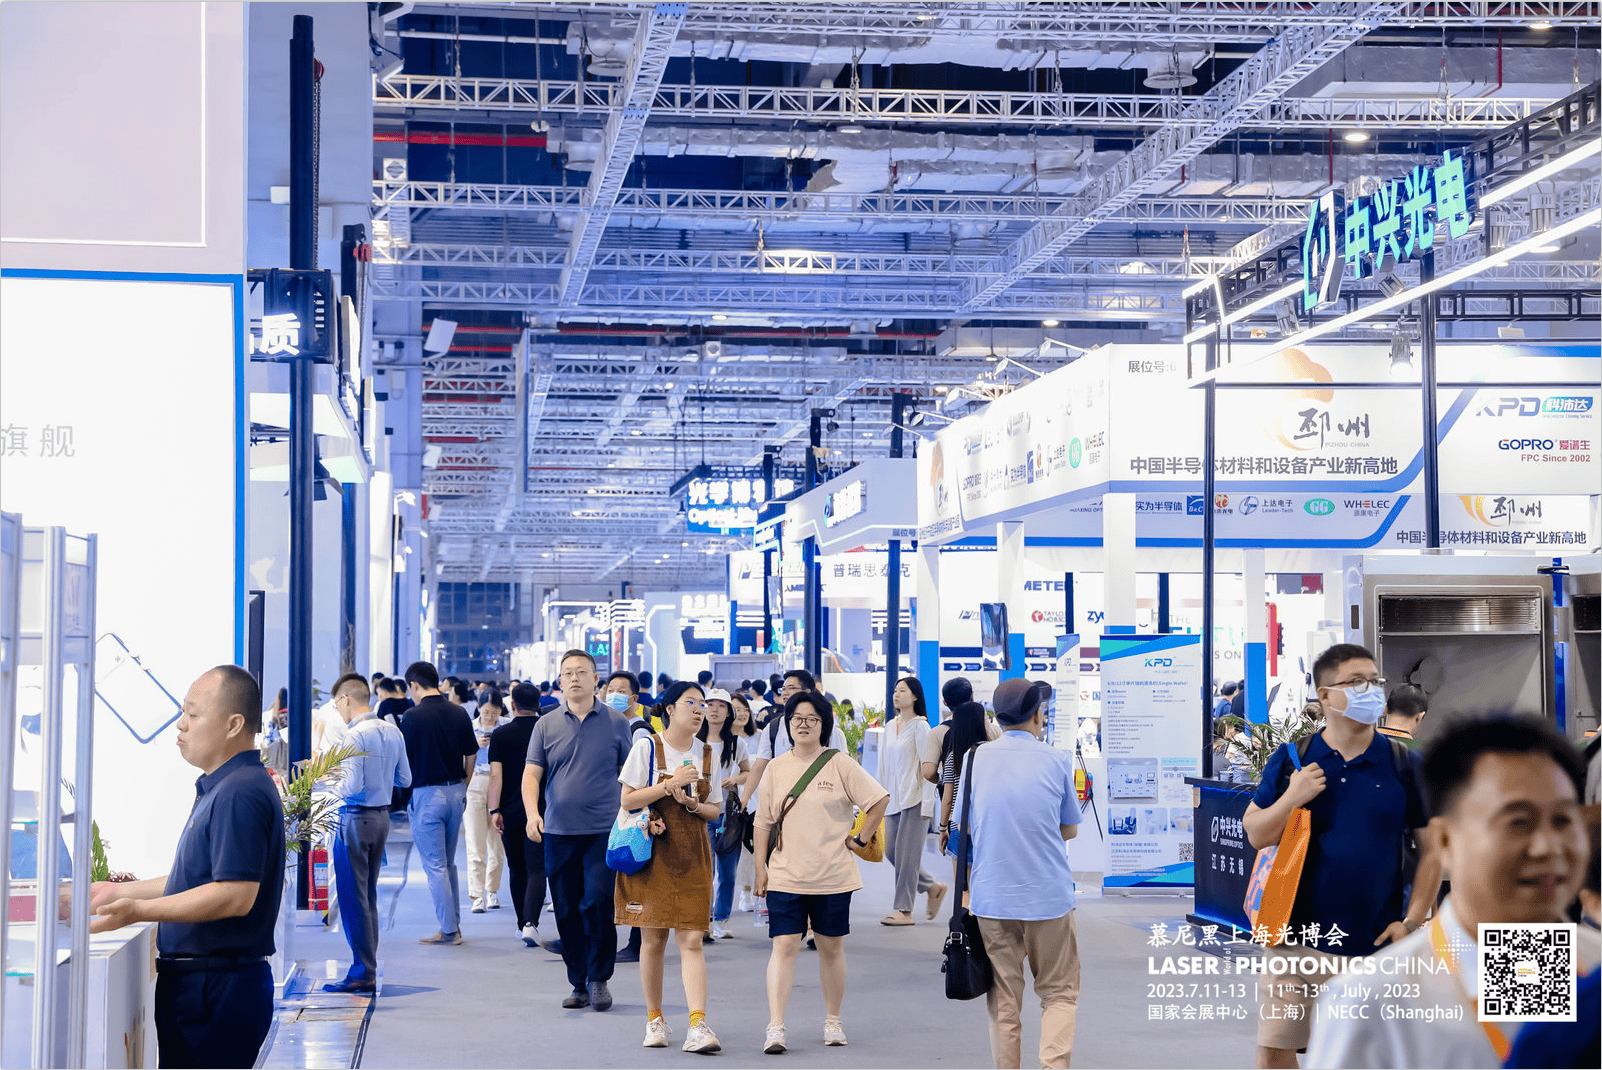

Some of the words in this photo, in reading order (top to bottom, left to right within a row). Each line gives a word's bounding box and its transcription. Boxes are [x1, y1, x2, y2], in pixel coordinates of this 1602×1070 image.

[1345, 150, 1469, 279] 中兴光电
[250, 313, 300, 356] 质
[1, 423, 75, 457] 旗舰
[1498, 439, 1554, 450] GOPRO
[1521, 454, 1540, 462] FPC
[1542, 454, 1567, 462] Since
[1569, 454, 1590, 462] 2002
[1262, 499, 1293, 507] 上达电子
[1024, 580, 1066, 591] METE
[1145, 658, 1173, 667] KPD
[1220, 815, 1243, 839] 中兴光电
